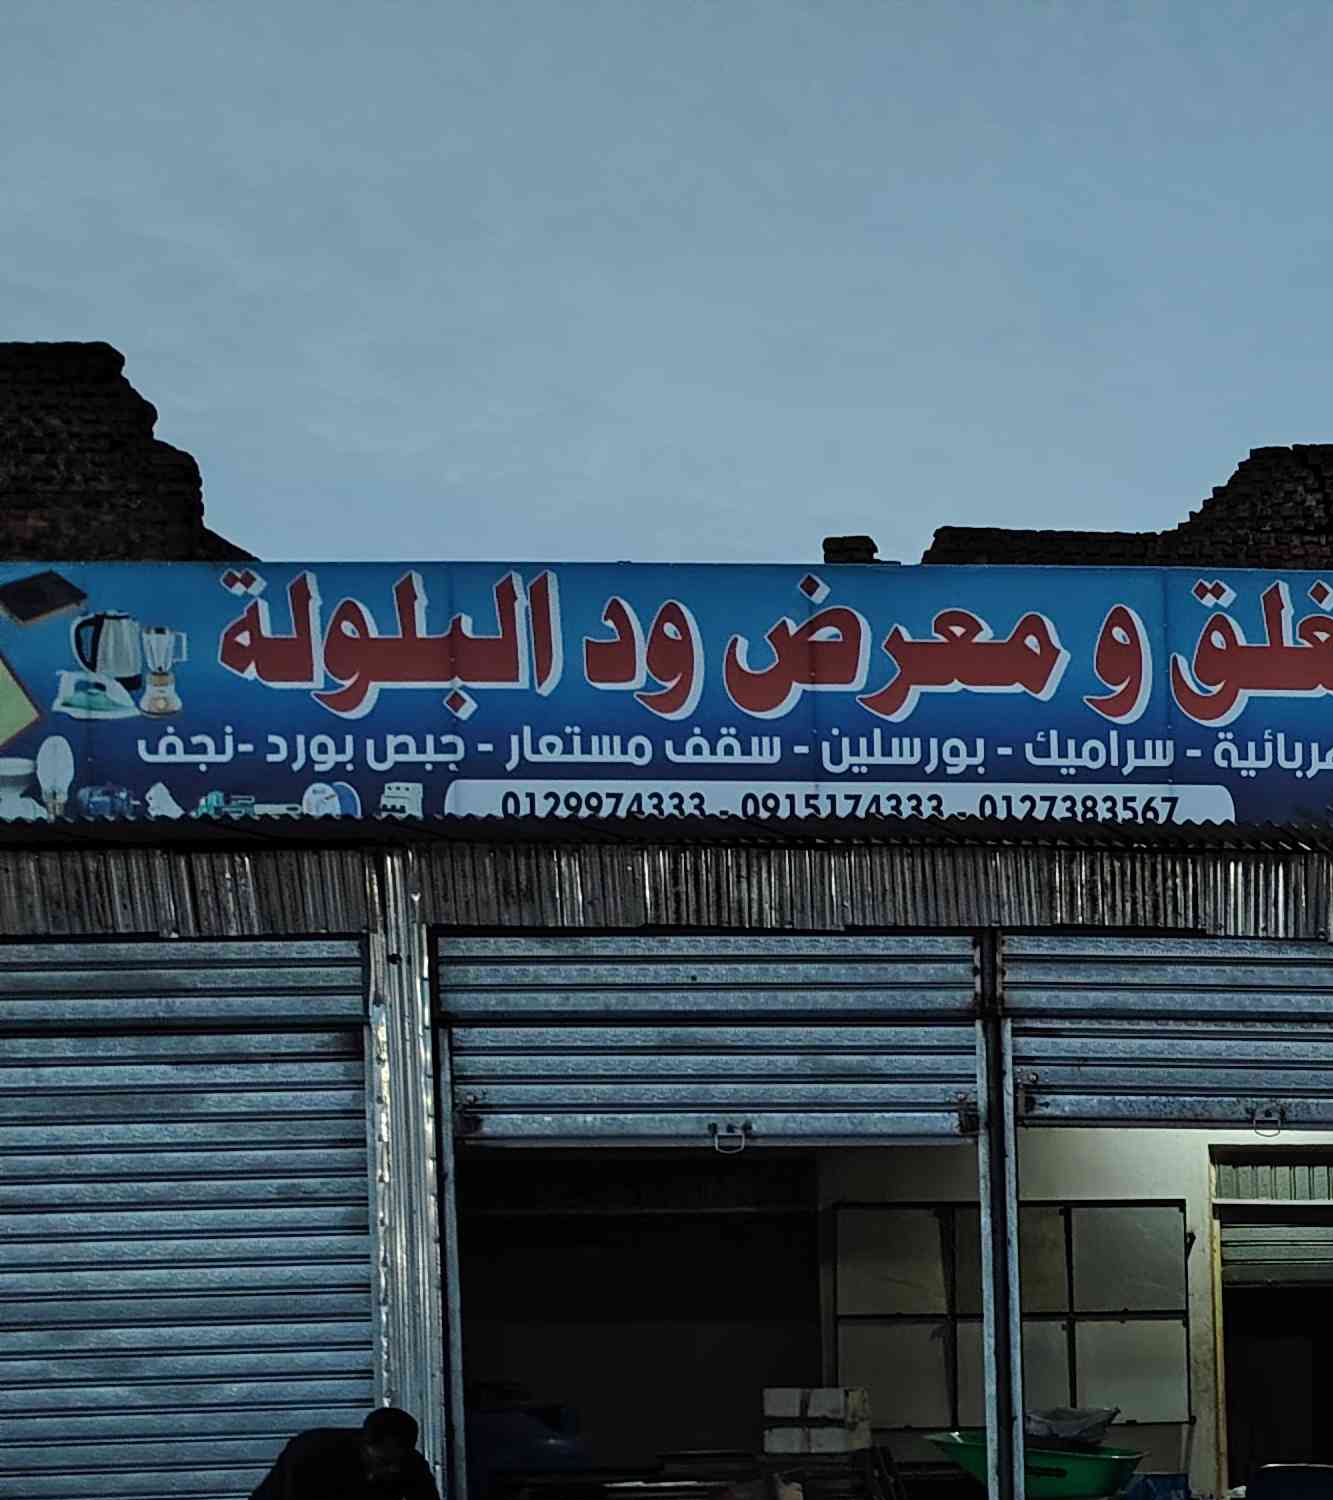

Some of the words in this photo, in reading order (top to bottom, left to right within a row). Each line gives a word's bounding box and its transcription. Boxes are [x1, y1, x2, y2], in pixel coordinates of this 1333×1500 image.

[217, 567, 564, 720] البلولة
[583, 594, 706, 721] ود
[722, 573, 1072, 723] معرض
[1083, 600, 1153, 725] و
[265, 732, 354, 771] بورد
[366, 731, 466, 771] جبص
[505, 726, 653, 771] مستعار
[664, 726, 781, 764] سقف
[820, 727, 986, 775] بورسلين
[1024, 729, 1175, 776] سراميك
[502, 791, 706, 817] 0129974333
[741, 792, 944, 818] 0915174333
[979, 794, 1179, 822] 0127383567
